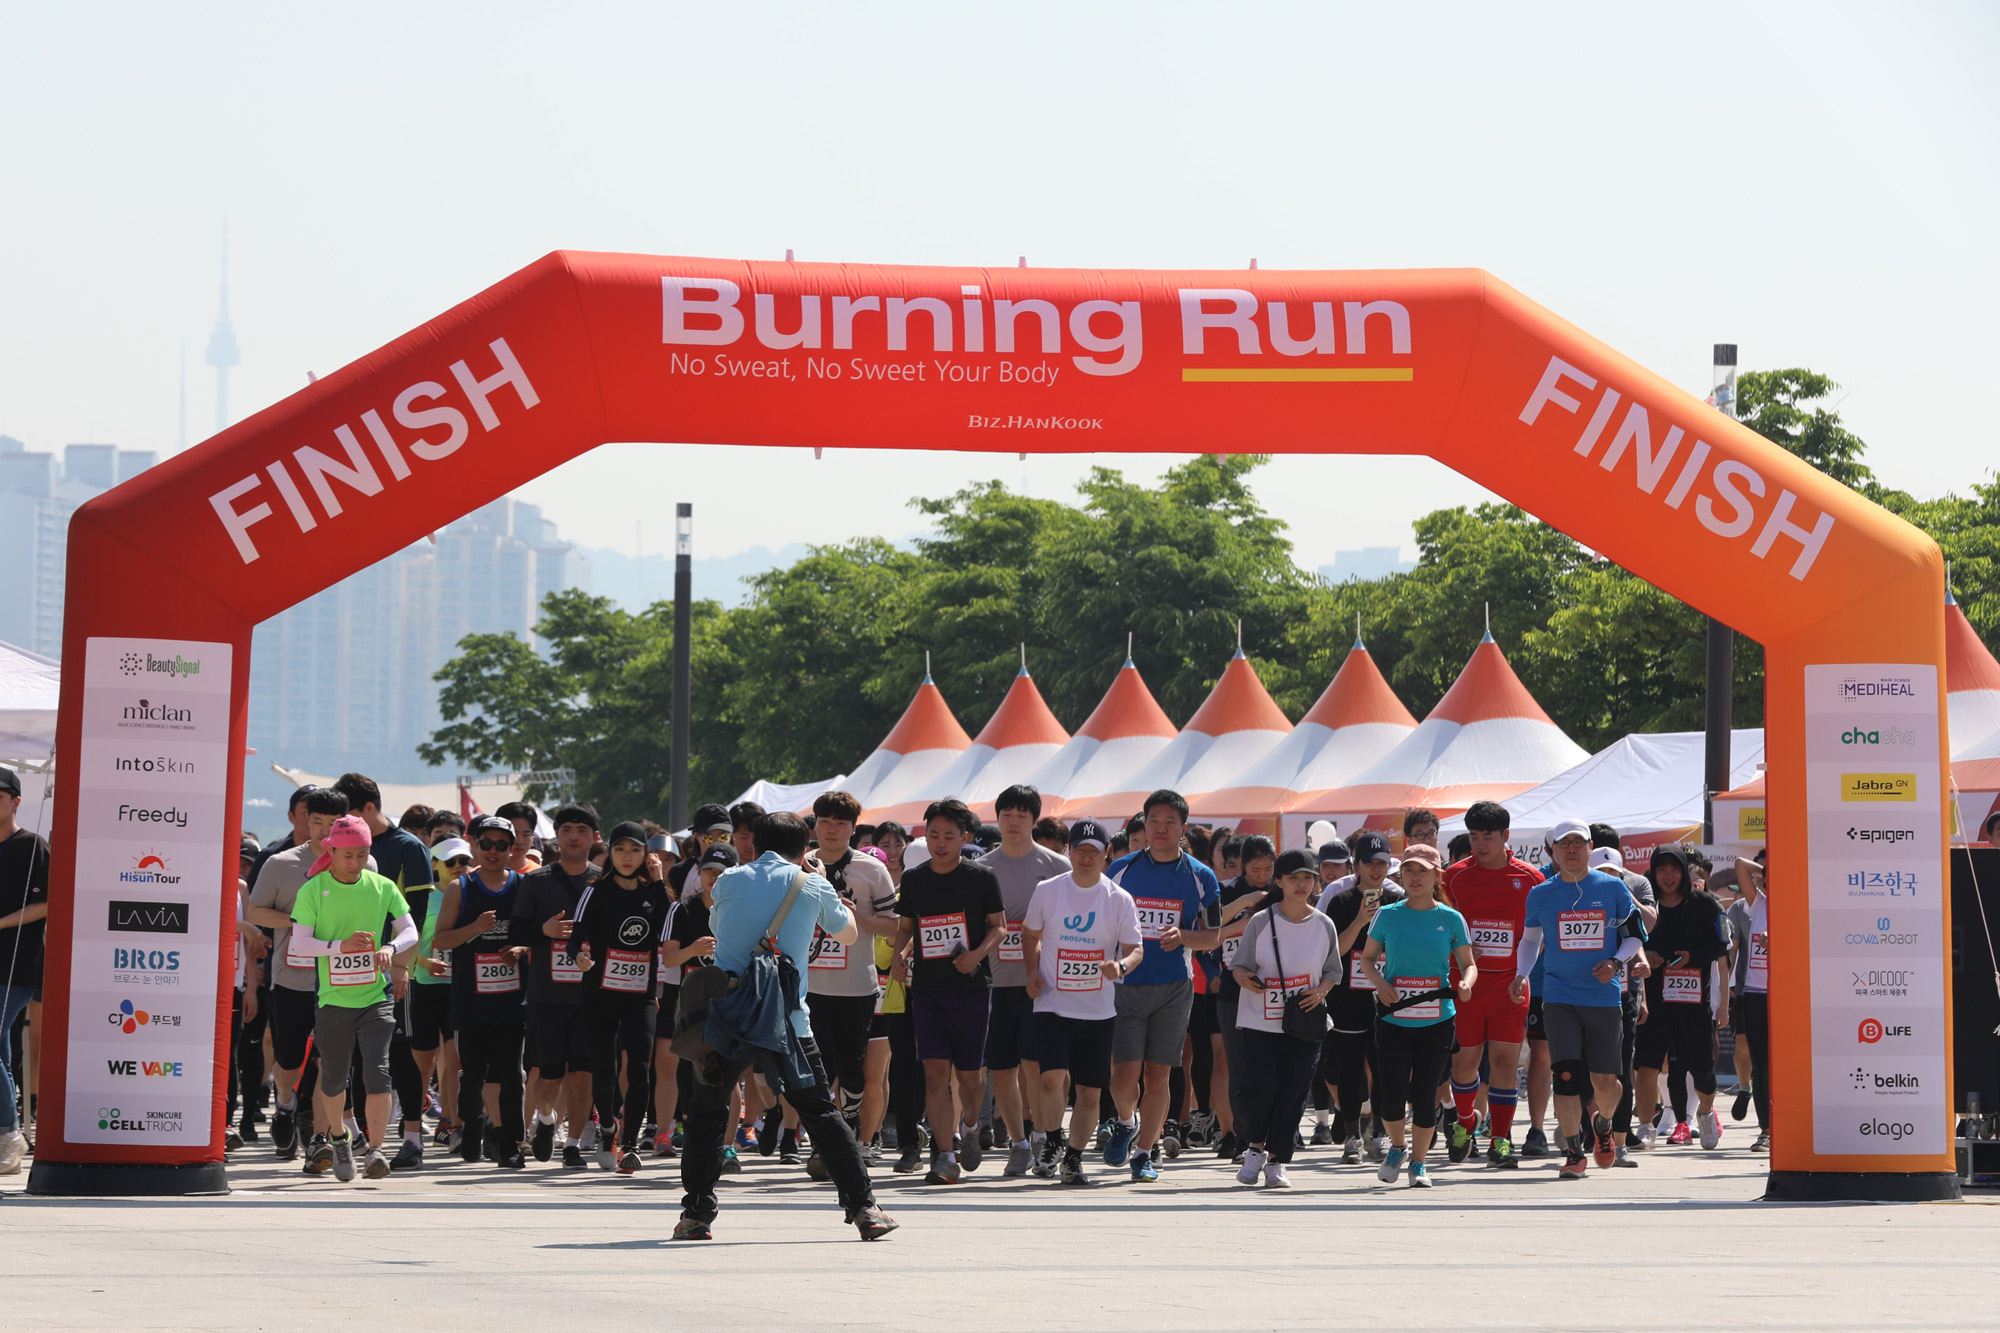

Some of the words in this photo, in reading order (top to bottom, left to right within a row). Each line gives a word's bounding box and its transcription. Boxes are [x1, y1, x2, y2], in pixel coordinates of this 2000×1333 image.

[661, 276, 1143, 376] Burning
[1178, 288, 1412, 357] Run
[671, 353, 705, 375] No
[714, 354, 797, 382] Sweat,
[807, 357, 841, 380] No
[850, 358, 926, 382] Sweet
[935, 360, 991, 382] Your
[1000, 360, 1060, 387] Body
[208, 336, 541, 565] FINISH
[1518, 355, 1836, 582] FINISH
[1844, 683, 1915, 696] MEDIHEAL
[123, 703, 192, 722] miclan
[1852, 780, 1893, 791] Jabra
[1895, 780, 1909, 788] GN
[118, 805, 188, 828] Freedy
[1860, 829, 1914, 844] spigen
[120, 871, 181, 885] HisunTour
[1847, 871, 1919, 897] 비즈한국
[920, 916, 947, 925] Burning
[1138, 910, 1176, 925] 2115
[1472, 919, 1499, 928] Burning
[924, 926, 961, 942] 2012
[1564, 922, 1600, 935] 3077
[1003, 933, 1023, 945] 26
[1059, 935, 1096, 944] PROSPECS
[1474, 930, 1509, 943] 2928
[1845, 933, 1918, 945] COWAROBOT
[1225, 939, 1241, 952] 21
[113, 948, 180, 971] BROS
[333, 954, 371, 969] 2058
[556, 954, 577, 967] 28
[1060, 950, 1089, 959] Burning
[481, 964, 515, 978] 2803
[610, 962, 646, 977] 2589
[1062, 962, 1099, 976] 2525
[113, 974, 140, 985] 브로스
[142, 974, 152, 985] 눈
[155, 975, 180, 986] 안마기
[1668, 977, 1698, 989] 2520
[108, 1013, 124, 1027] CJ
[151, 1014, 182, 1027] 푸드빌
[1885, 1026, 1912, 1036] LIFE
[107, 1060, 137, 1076] WE
[141, 1061, 183, 1077] VAPE
[1874, 1073, 1919, 1088] belkin
[146, 1111, 183, 1120] SKINCURE
[109, 1119, 183, 1132] CELLTRION
[1859, 1118, 1915, 1140] elago
